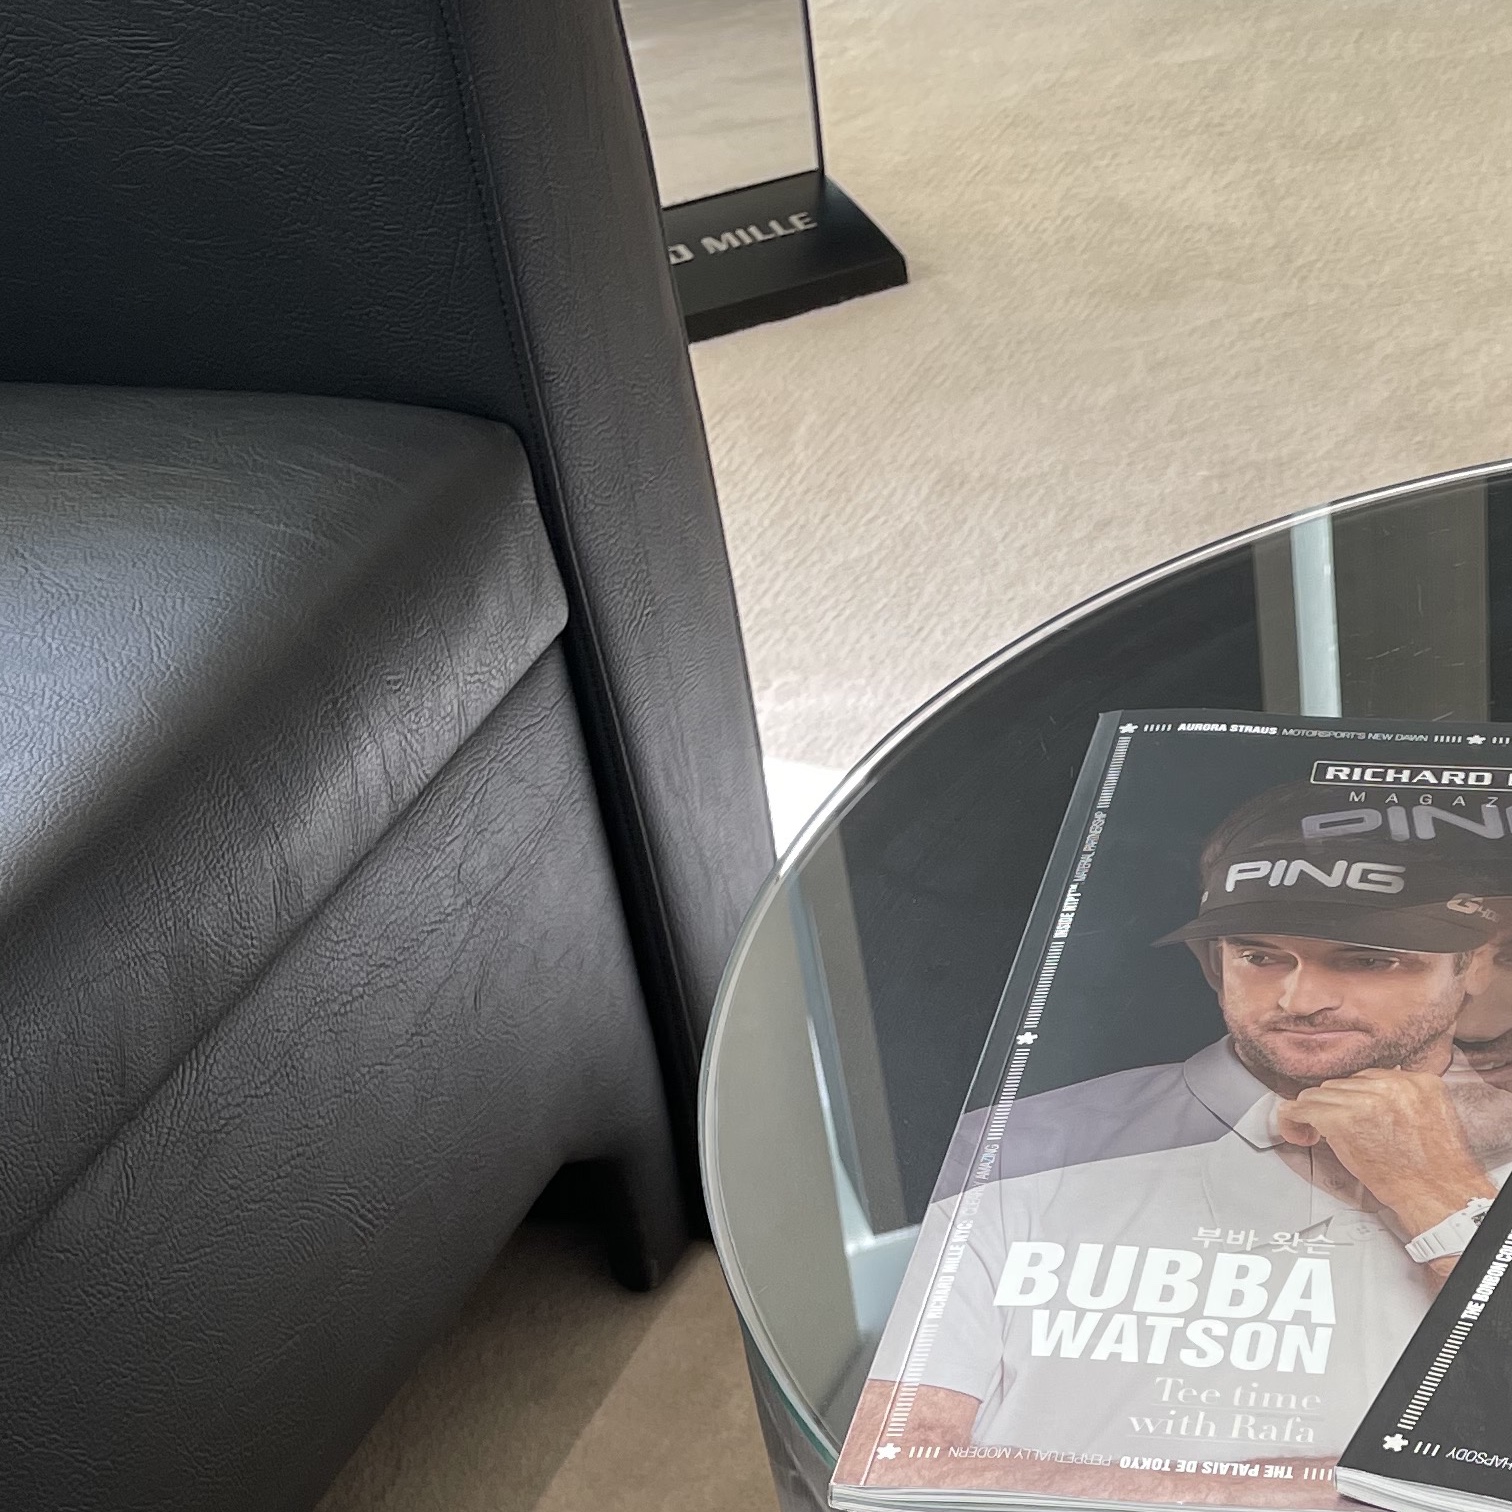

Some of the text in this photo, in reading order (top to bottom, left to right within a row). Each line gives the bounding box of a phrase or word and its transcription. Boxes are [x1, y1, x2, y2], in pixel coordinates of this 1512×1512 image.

[700, 211, 819, 255] MILLE
[1177, 722, 1227, 731] AURORA
[1368, 732, 1393, 740] NEW
[1394, 733, 1428, 742] DAWN
[1325, 766, 1493, 786] RICHARD
[1224, 859, 1407, 894] PING
[975, 1144, 999, 1180] AMAZING
[1191, 1226, 1336, 1255] 부바 왓슨
[993, 1240, 1337, 1325] BUBBA
[1472, 1260, 1509, 1302] BONBON
[1461, 1300, 1486, 1321] THE
[1030, 1308, 1334, 1375] WATSON
[1155, 1376, 1322, 1411] Tee time
[1127, 1409, 1316, 1444] with Rafa
[947, 1446, 1293, 1479] THE PALAIS DE TOKYO PERPETUALLY MODERN
